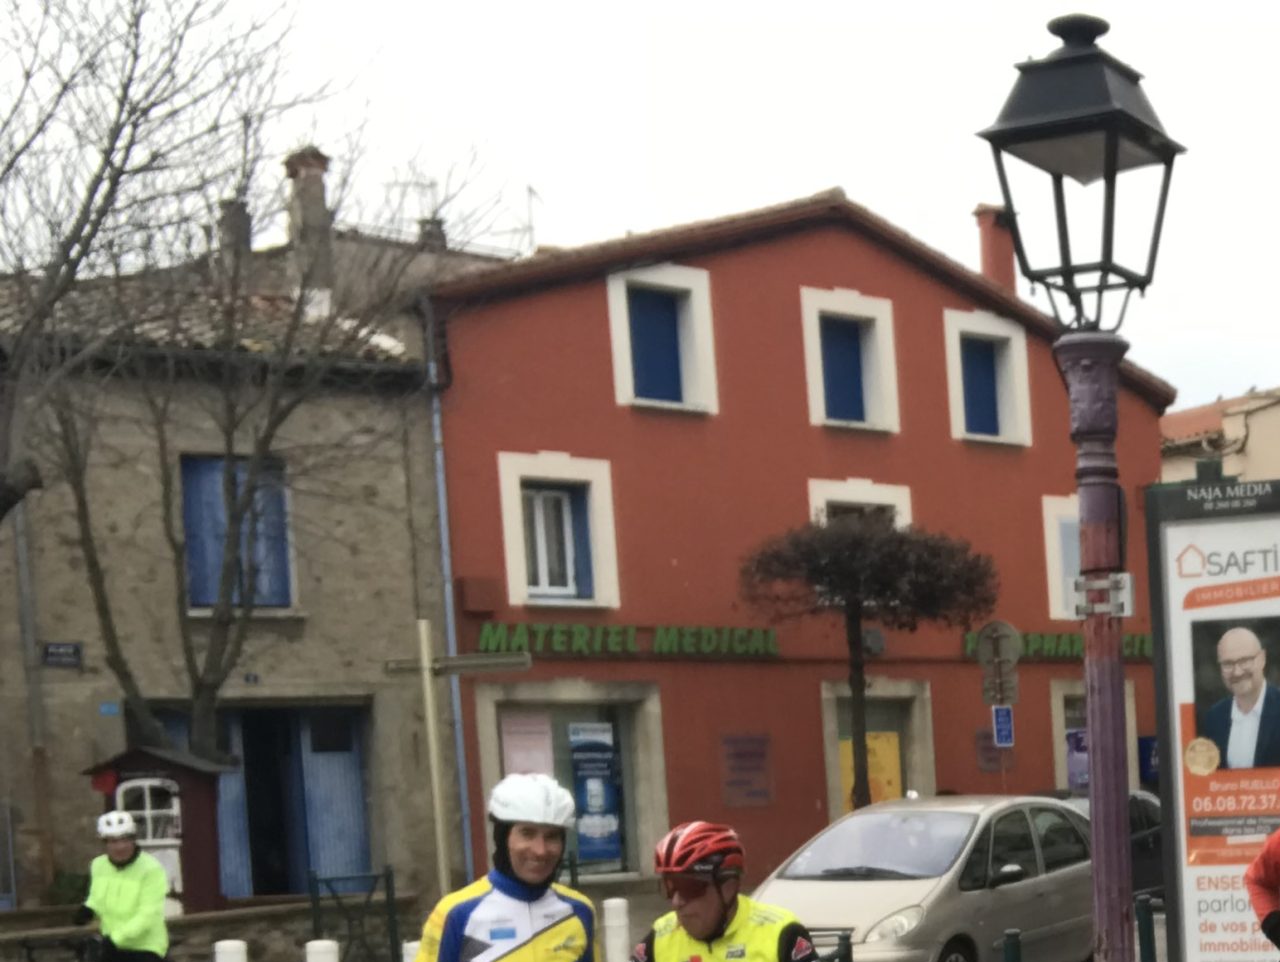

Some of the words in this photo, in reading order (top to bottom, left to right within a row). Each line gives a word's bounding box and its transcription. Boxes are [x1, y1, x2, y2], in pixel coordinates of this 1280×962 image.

[1187, 486, 1222, 501] NAJA
[1226, 483, 1272, 498] MEDIA
[1195, 580, 1280, 602] IMMOBILIER
[479, 623, 640, 654] MATERIEL
[654, 625, 780, 657] MEDICAL
[1198, 895, 1250, 916] parlo
[1199, 920, 1216, 933] de
[1221, 922, 1247, 933] vos
